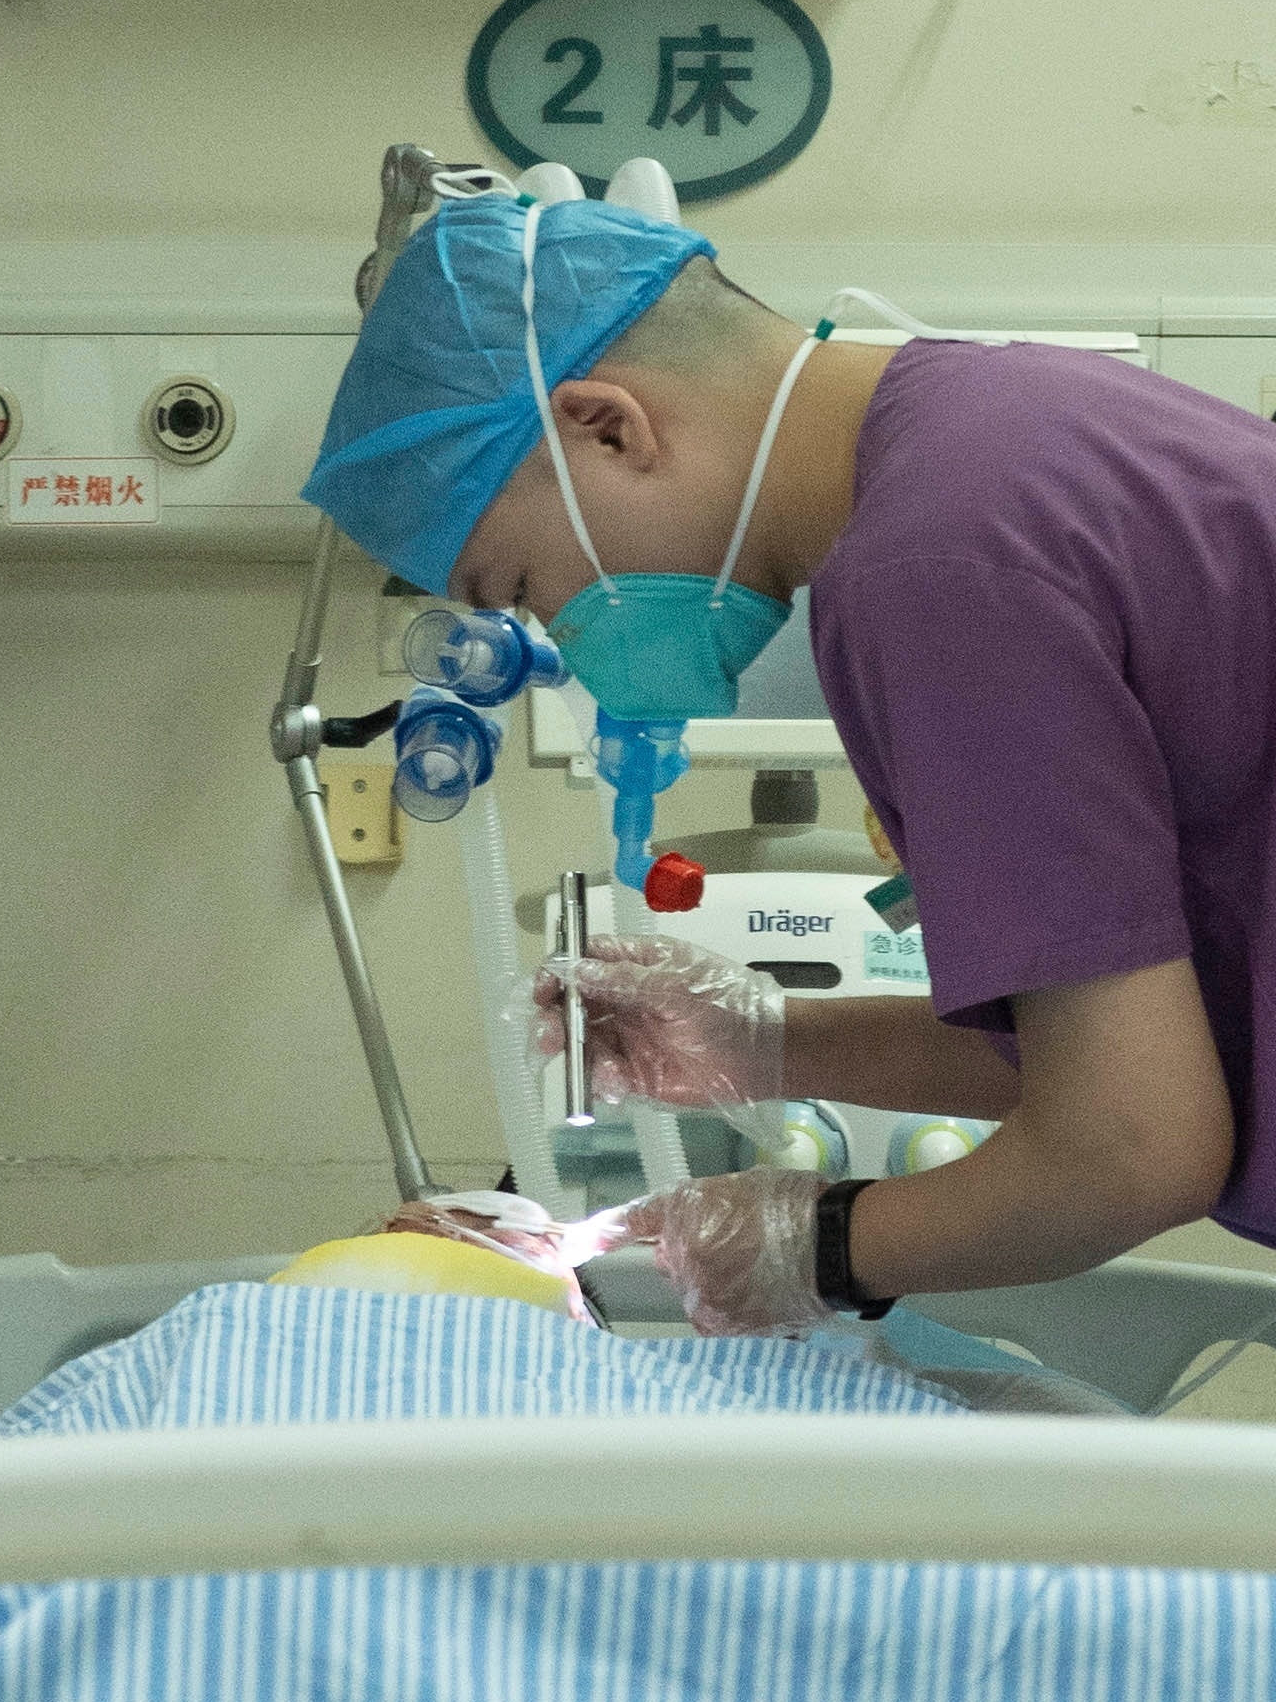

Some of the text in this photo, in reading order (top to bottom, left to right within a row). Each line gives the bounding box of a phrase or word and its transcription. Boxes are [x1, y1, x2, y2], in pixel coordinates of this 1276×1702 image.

[20, 474, 145, 507] 严禁烟火
[748, 908, 835, 937] Dräger
